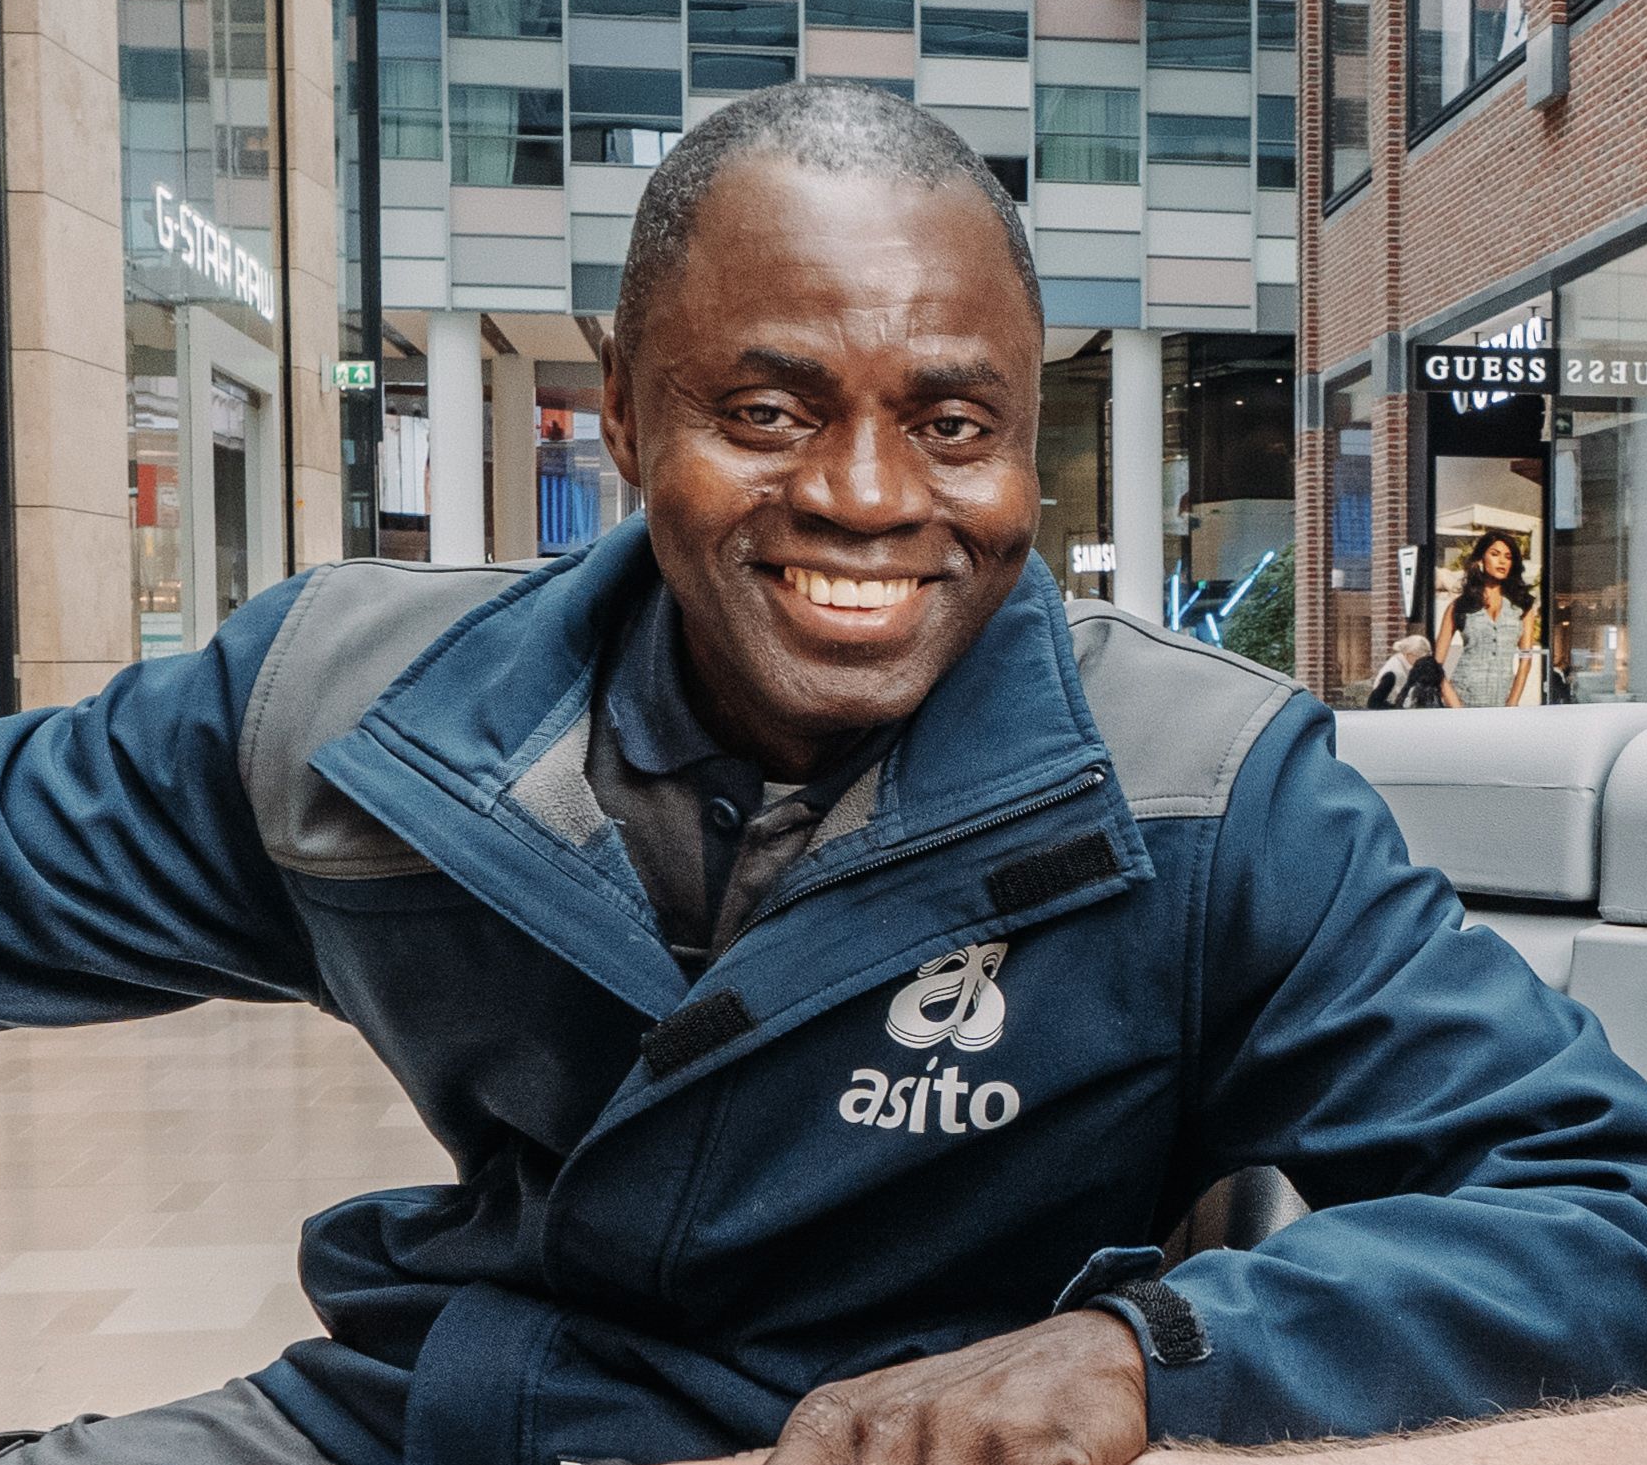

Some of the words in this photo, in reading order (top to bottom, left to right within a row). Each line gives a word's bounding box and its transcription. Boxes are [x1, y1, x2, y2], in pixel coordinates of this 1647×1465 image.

[156, 186, 232, 287] G-STAR
[235, 247, 274, 321] RAW
[1425, 355, 1546, 383] GUESS
[838, 1056, 1021, 1134] asito
